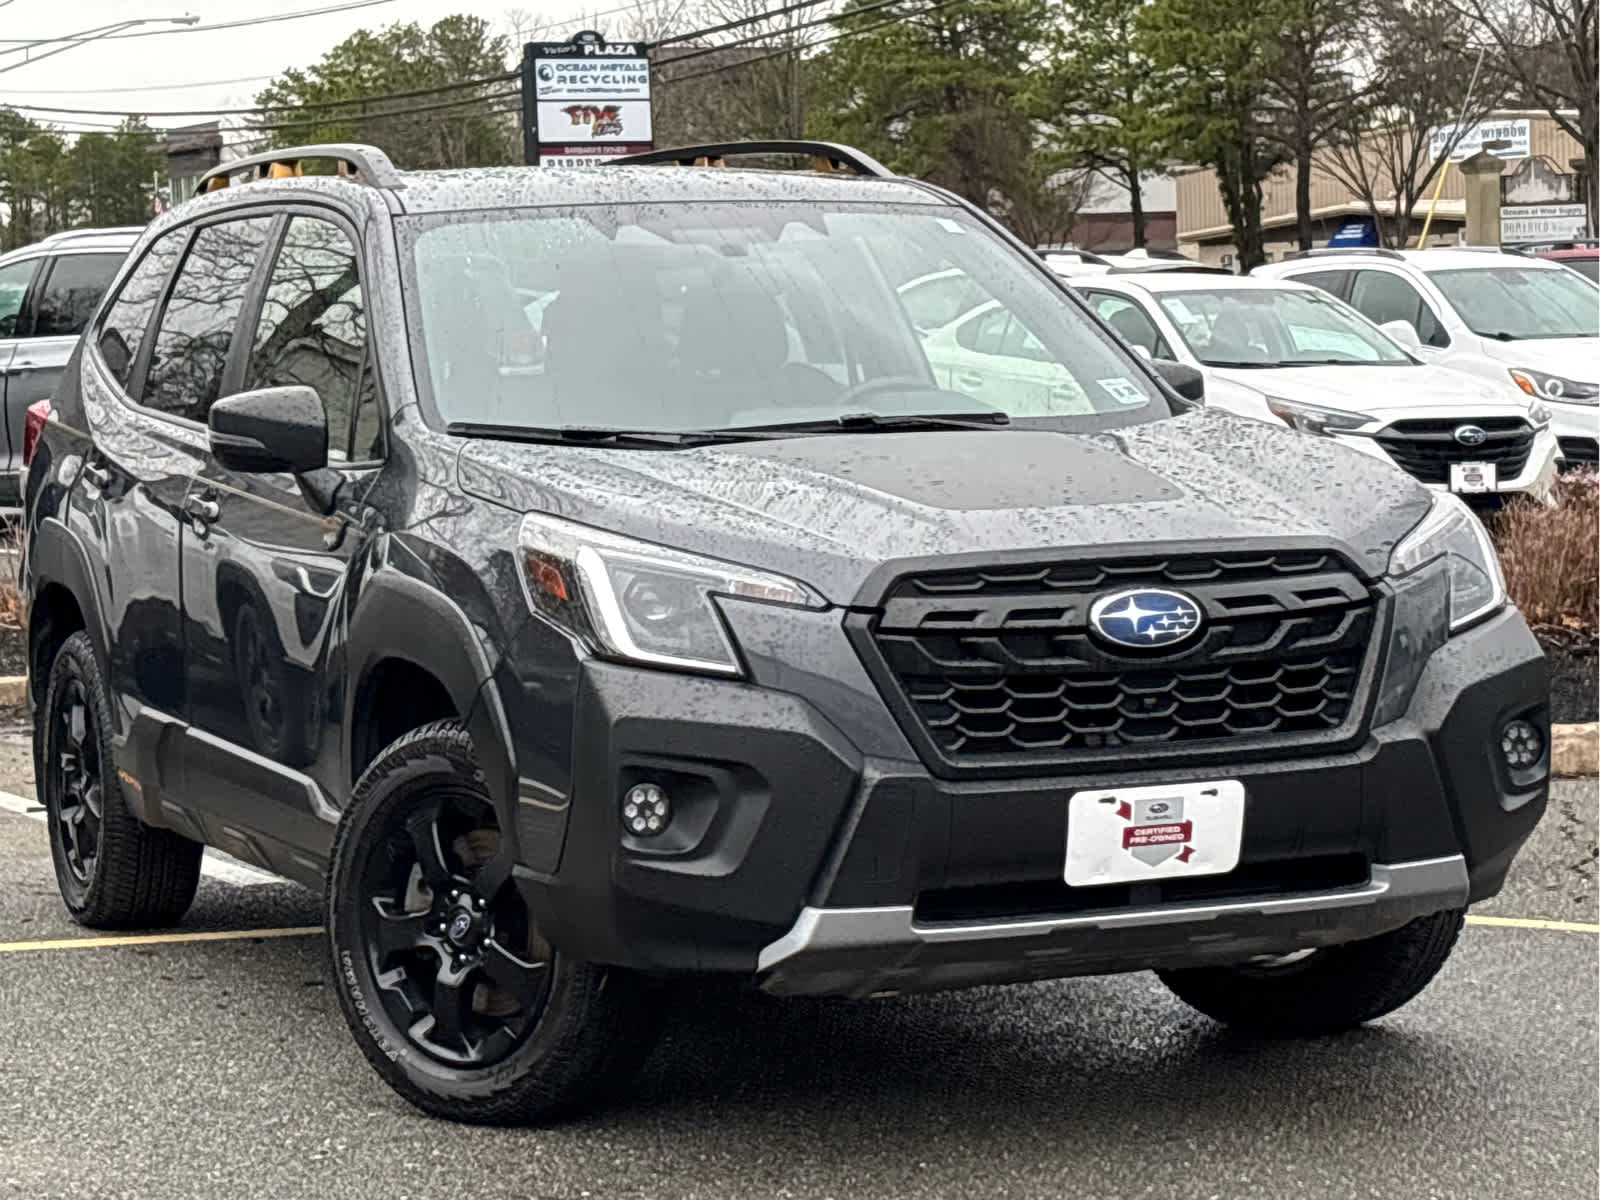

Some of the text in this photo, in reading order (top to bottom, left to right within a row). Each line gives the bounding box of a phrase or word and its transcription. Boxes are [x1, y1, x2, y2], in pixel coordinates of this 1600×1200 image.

[583, 45, 637, 55] PLAZA
[556, 63, 647, 72] OCEAN METALS
[557, 75, 647, 84] RECYCLING
[1481, 126, 1527, 138] WINDOW
[1134, 826, 1181, 836] CERTIFIED
[1130, 833, 1184, 844] PRE-OWNED
